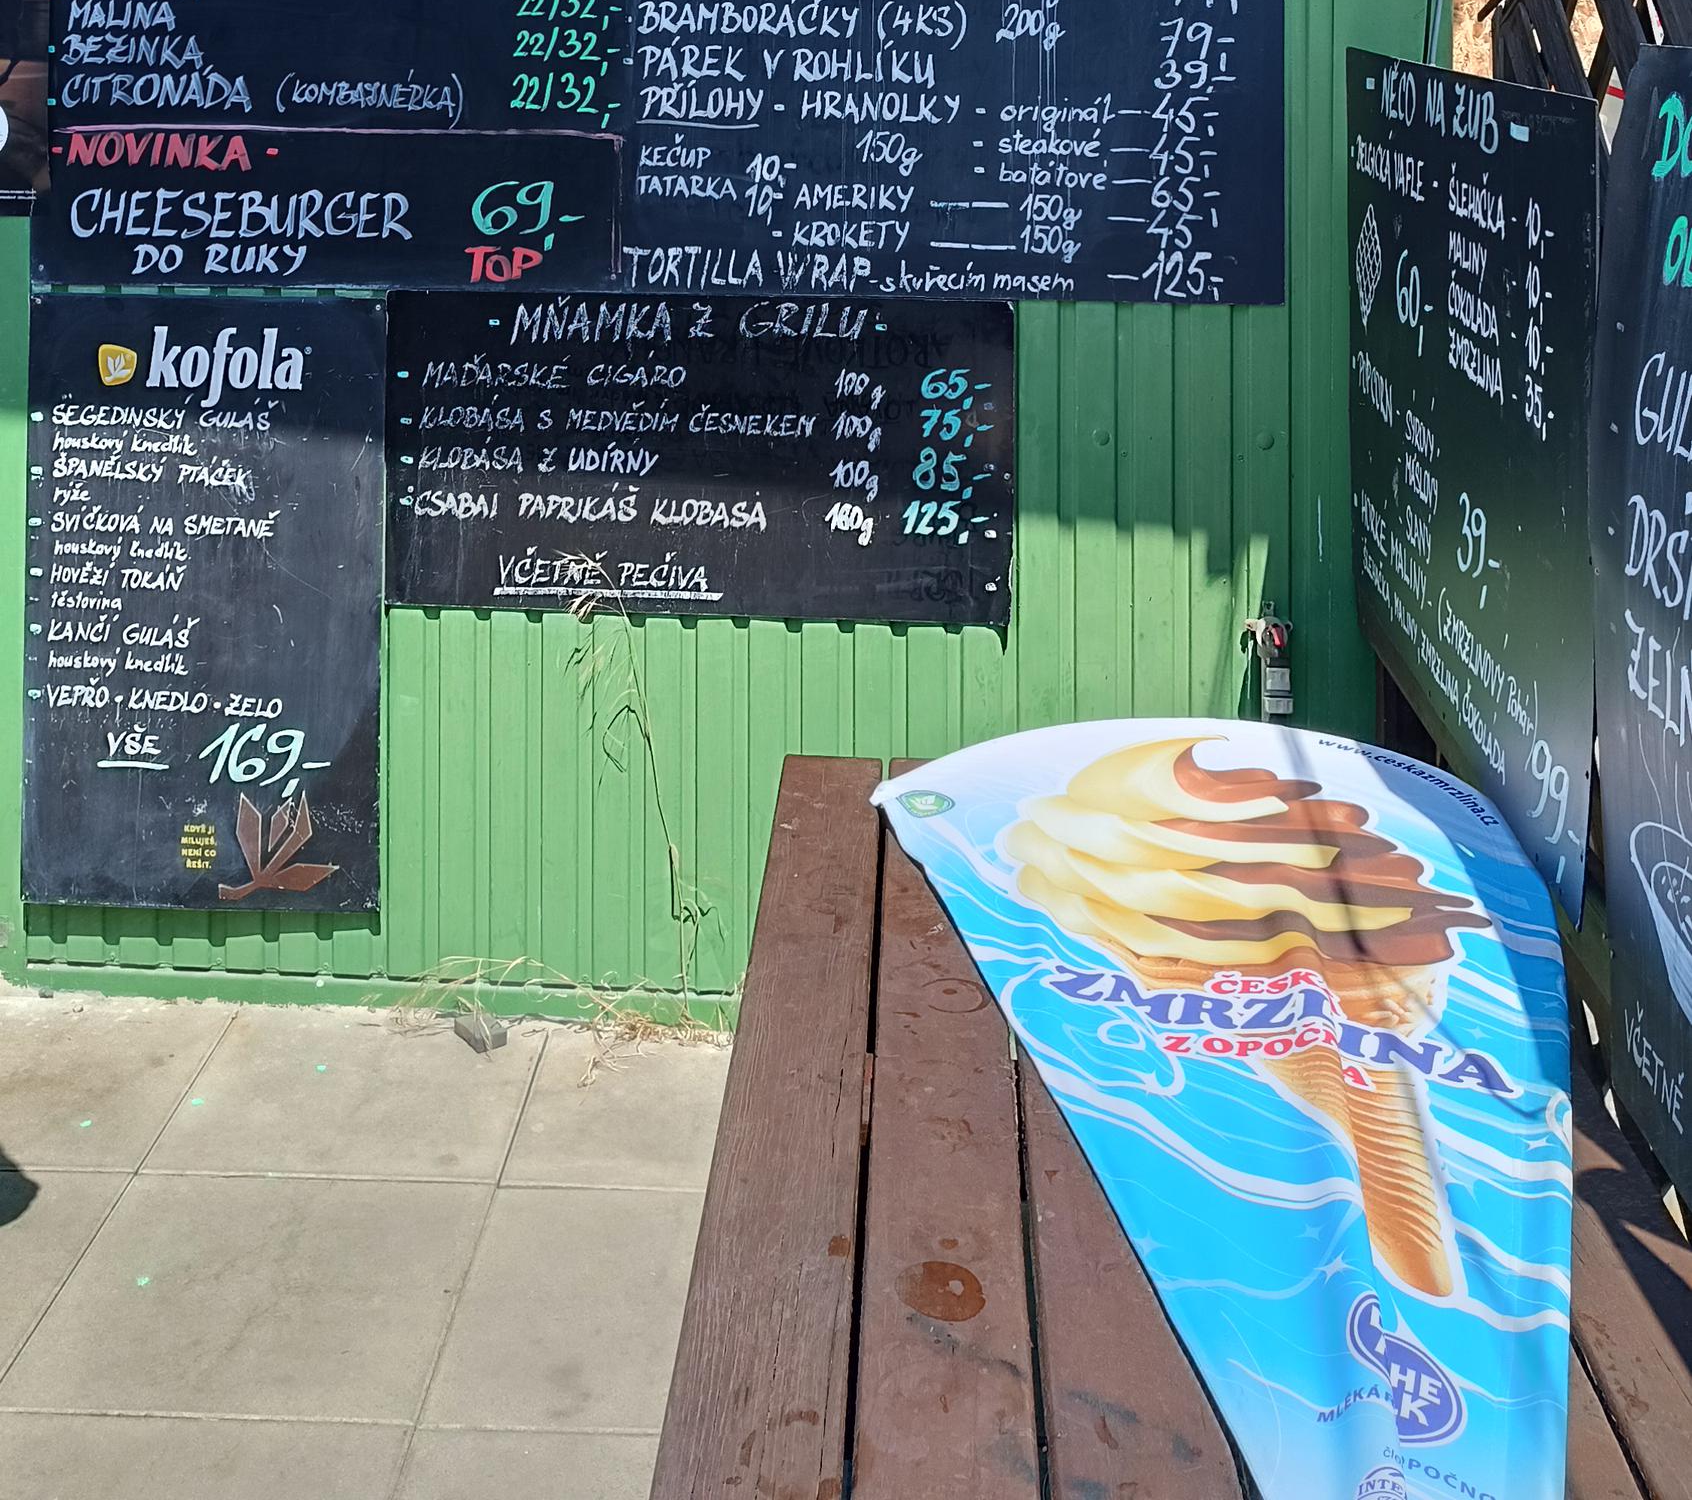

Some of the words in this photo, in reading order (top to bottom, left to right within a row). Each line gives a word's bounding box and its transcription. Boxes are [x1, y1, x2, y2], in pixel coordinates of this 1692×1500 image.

[67, 0, 176, 32] MALINA
[876, 1, 966, 50] (4KS)
[60, 34, 204, 69] BEZINKA
[637, 35, 746, 82] PÁREK
[763, 49, 783, 80] V
[792, 40, 935, 89] ROHLÍKU
[61, 65, 252, 112] CITRONÁDA
[640, 79, 764, 120] PŘÍLOHY
[801, 89, 960, 124] HRANOLKY
[1000, 94, 1115, 132] originál
[1381, 62, 1415, 127] NĚCO
[1425, 78, 1445, 137] NA
[1453, 82, 1498, 154] ZUB
[67, 132, 251, 171] NOVINKA
[639, 133, 711, 169] KEČUP
[998, 128, 1101, 158] steakové
[636, 175, 737, 201] TATARKA
[998, 160, 1108, 191] batátové
[70, 188, 412, 241] CHEESEBURGER
[794, 183, 915, 213] AMERIKY
[1448, 162, 1505, 240] ŠLEHAČKA
[791, 220, 910, 252] KROKETY
[1448, 230, 1487, 276] MALINY
[131, 244, 183, 275] DO
[204, 244, 307, 277] RUKY
[464, 246, 542, 283] TOP
[623, 246, 763, 289] TORTILLA
[992, 272, 1075, 294] masem
[510, 296, 671, 345] MŇAMKA
[688, 302, 714, 339] Z
[739, 301, 868, 340] GRILU
[146, 325, 304, 408] kofola
[587, 351, 686, 388] CIGÁRO
[199, 398, 279, 430] GULÁŠ
[419, 394, 524, 432] KLOBÁSA
[537, 409, 552, 430] S
[566, 398, 679, 433] MEDVĚDÍM
[53, 430, 128, 456] houskový
[418, 436, 523, 474] KLOBÁSA
[537, 448, 557, 473] Z
[568, 442, 659, 476] UDÍRNY
[54, 482, 91, 506] rýže
[413, 491, 499, 519] CSABAI
[518, 482, 639, 523] PAPRIKÁŠ
[50, 505, 143, 533] SVÍČKOVÁ
[150, 516, 173, 535] NA
[184, 510, 280, 538] SMETANĚ
[54, 536, 123, 566] houskový
[121, 564, 186, 591] TOKÁŇ
[618, 552, 709, 591] PEČIVA
[48, 614, 120, 642] KANČÍ
[122, 614, 200, 648] GULÁŠ
[49, 647, 121, 677] houskový
[128, 687, 208, 714] KNEDLO
[107, 723, 161, 756] VŠE
[1319, 739, 1499, 826] www.ceskazmrzlina.cz
